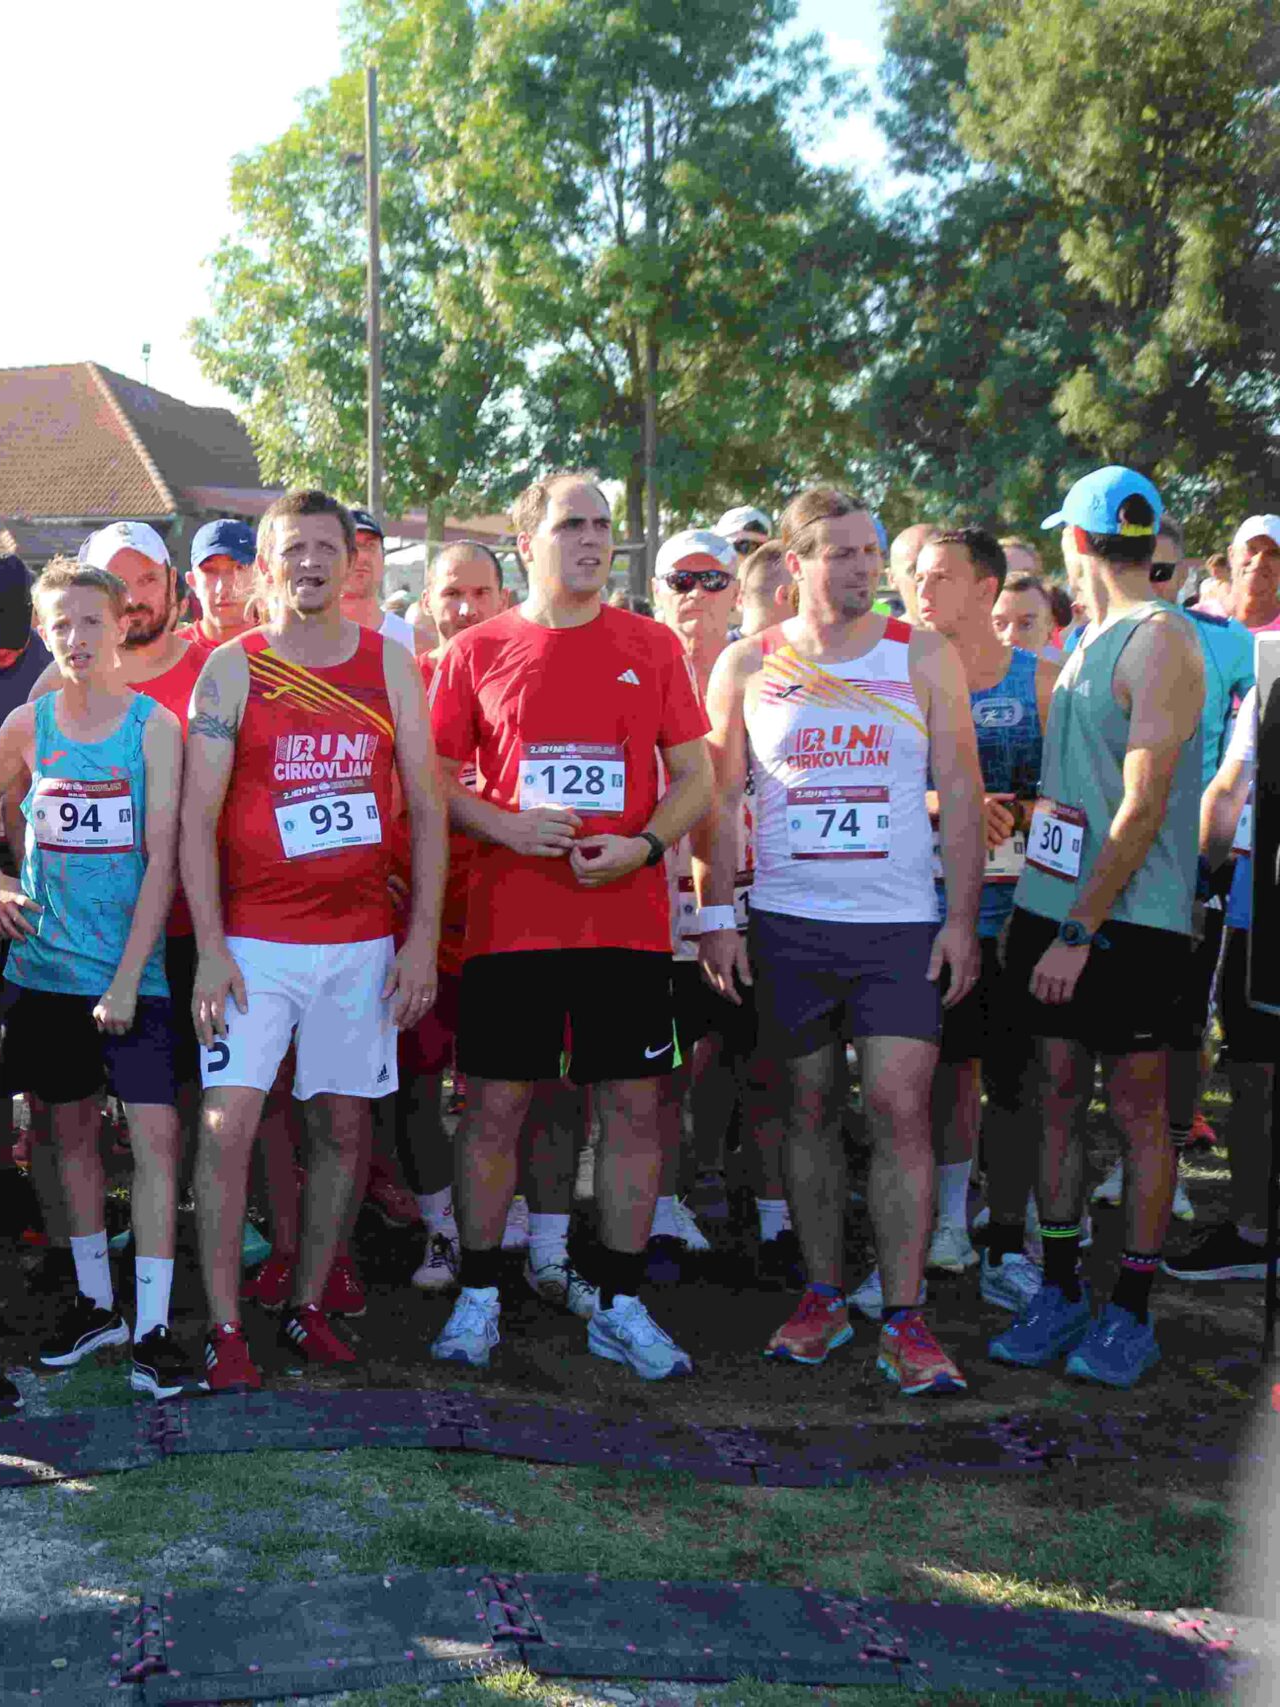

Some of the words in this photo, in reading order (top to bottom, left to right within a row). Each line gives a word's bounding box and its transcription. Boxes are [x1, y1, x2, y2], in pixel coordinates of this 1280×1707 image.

[291, 733, 363, 762] RUN
[786, 750, 889, 771] CIRKOVLJAN
[274, 761, 372, 781] CIRKOVLJAN
[540, 765, 605, 795] 128
[59, 802, 102, 833] 94
[309, 801, 354, 836] 93
[815, 808, 860, 838] 74
[1039, 819, 1063, 855] 30
